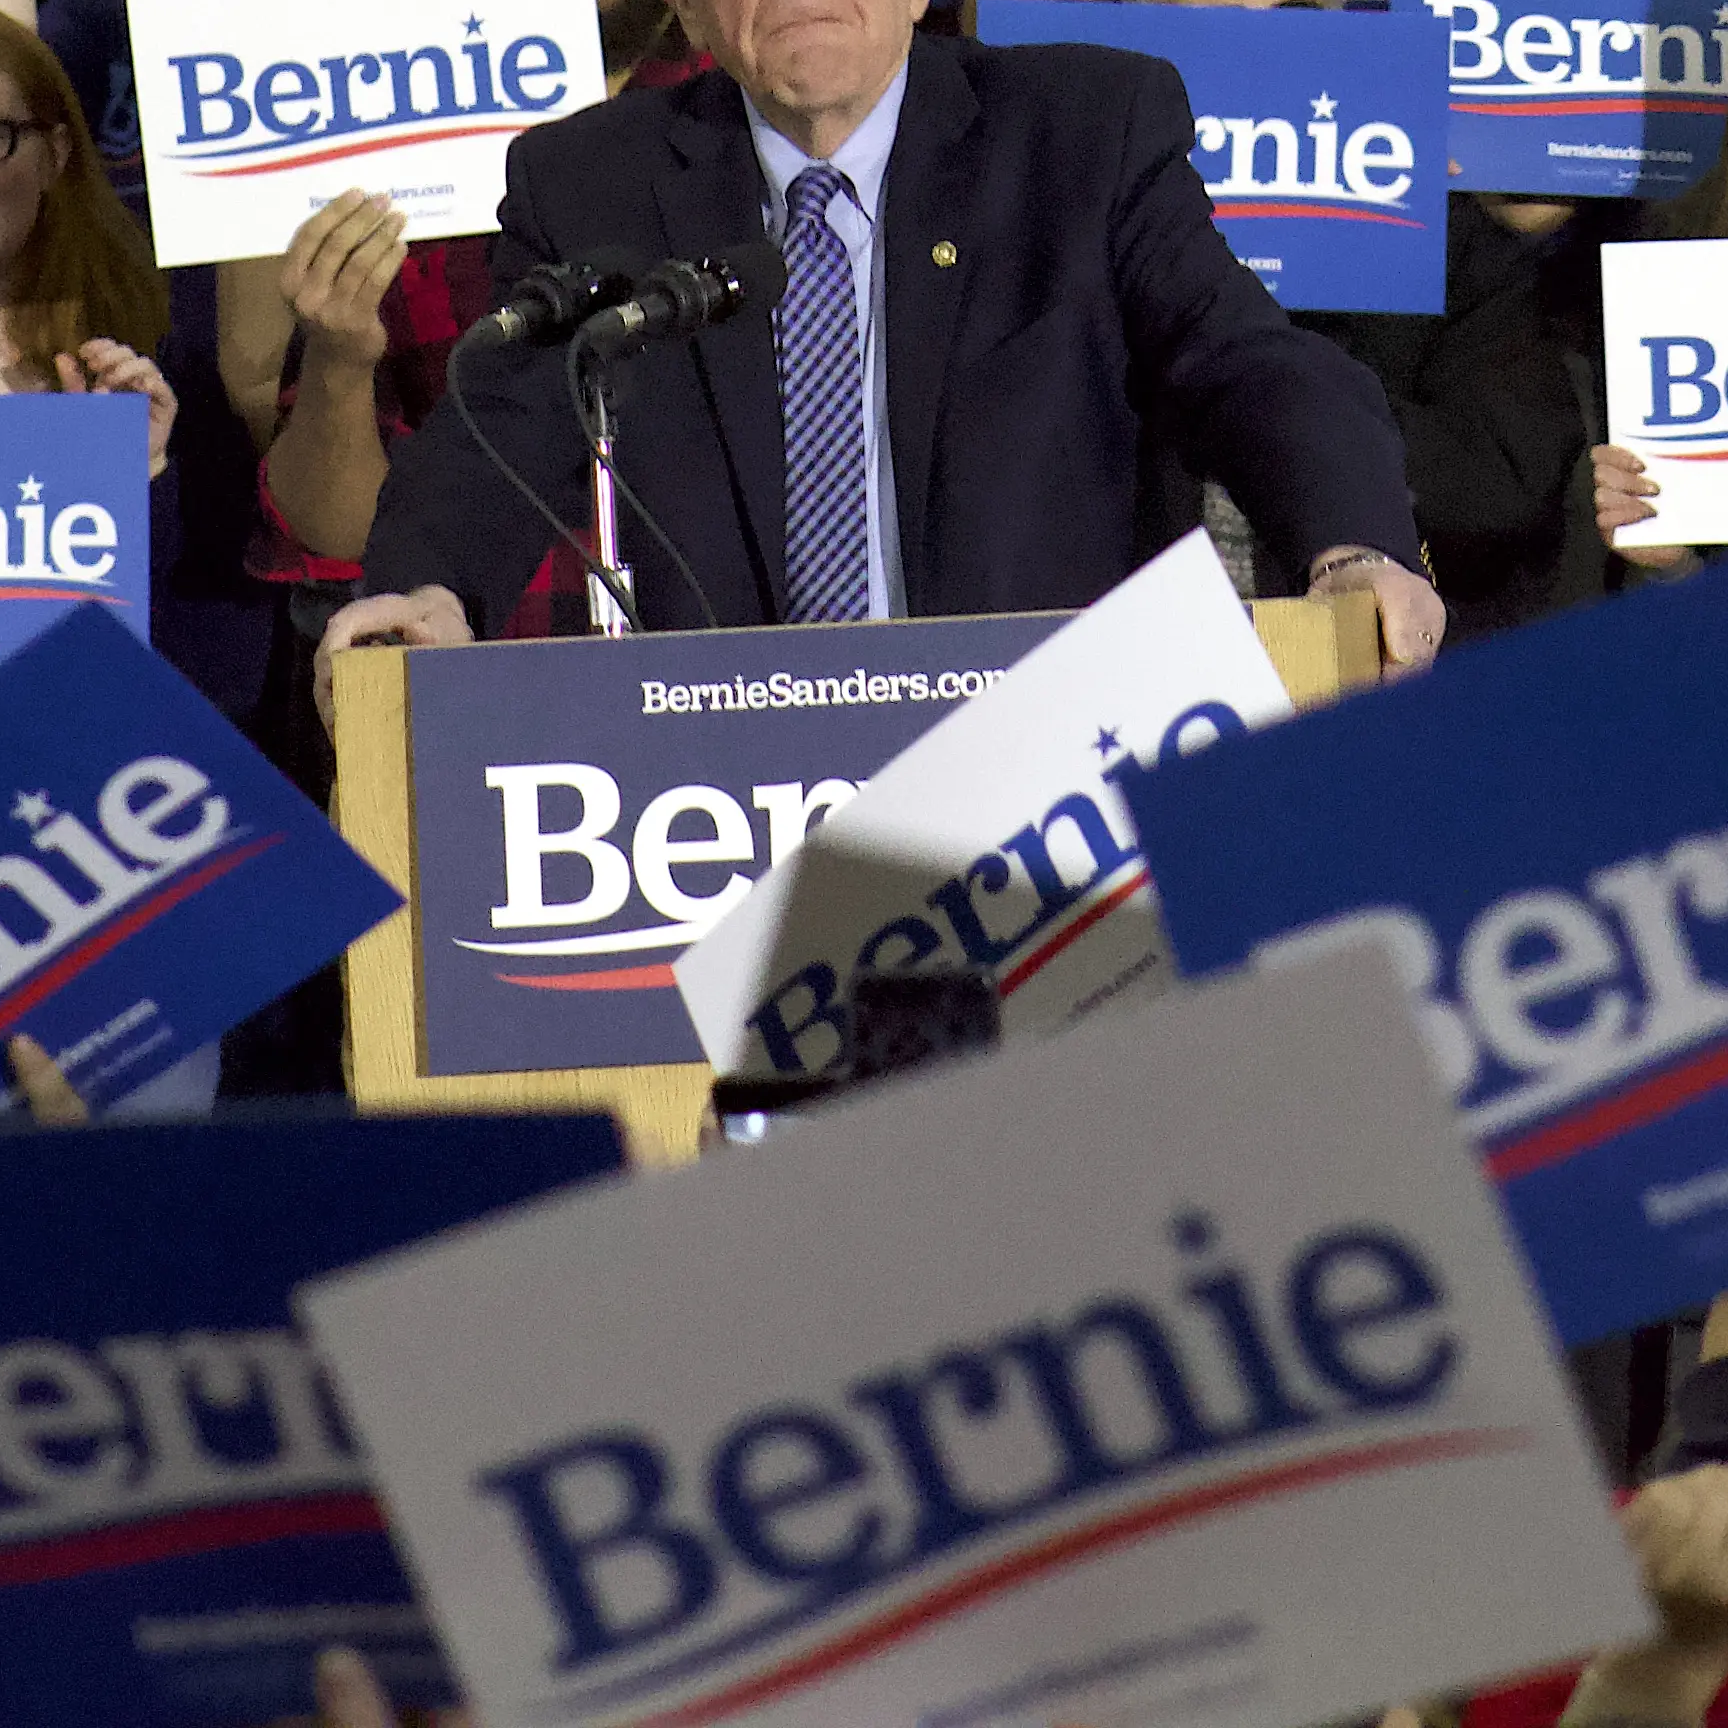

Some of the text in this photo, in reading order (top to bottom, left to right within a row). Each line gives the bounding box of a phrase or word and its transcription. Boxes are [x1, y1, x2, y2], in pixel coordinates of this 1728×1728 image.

[168, 11, 567, 145] Bernie
[1193, 91, 1415, 206] rnie
[485, 761, 872, 930] Ber
[474, 1206, 1463, 1670] Bernie
